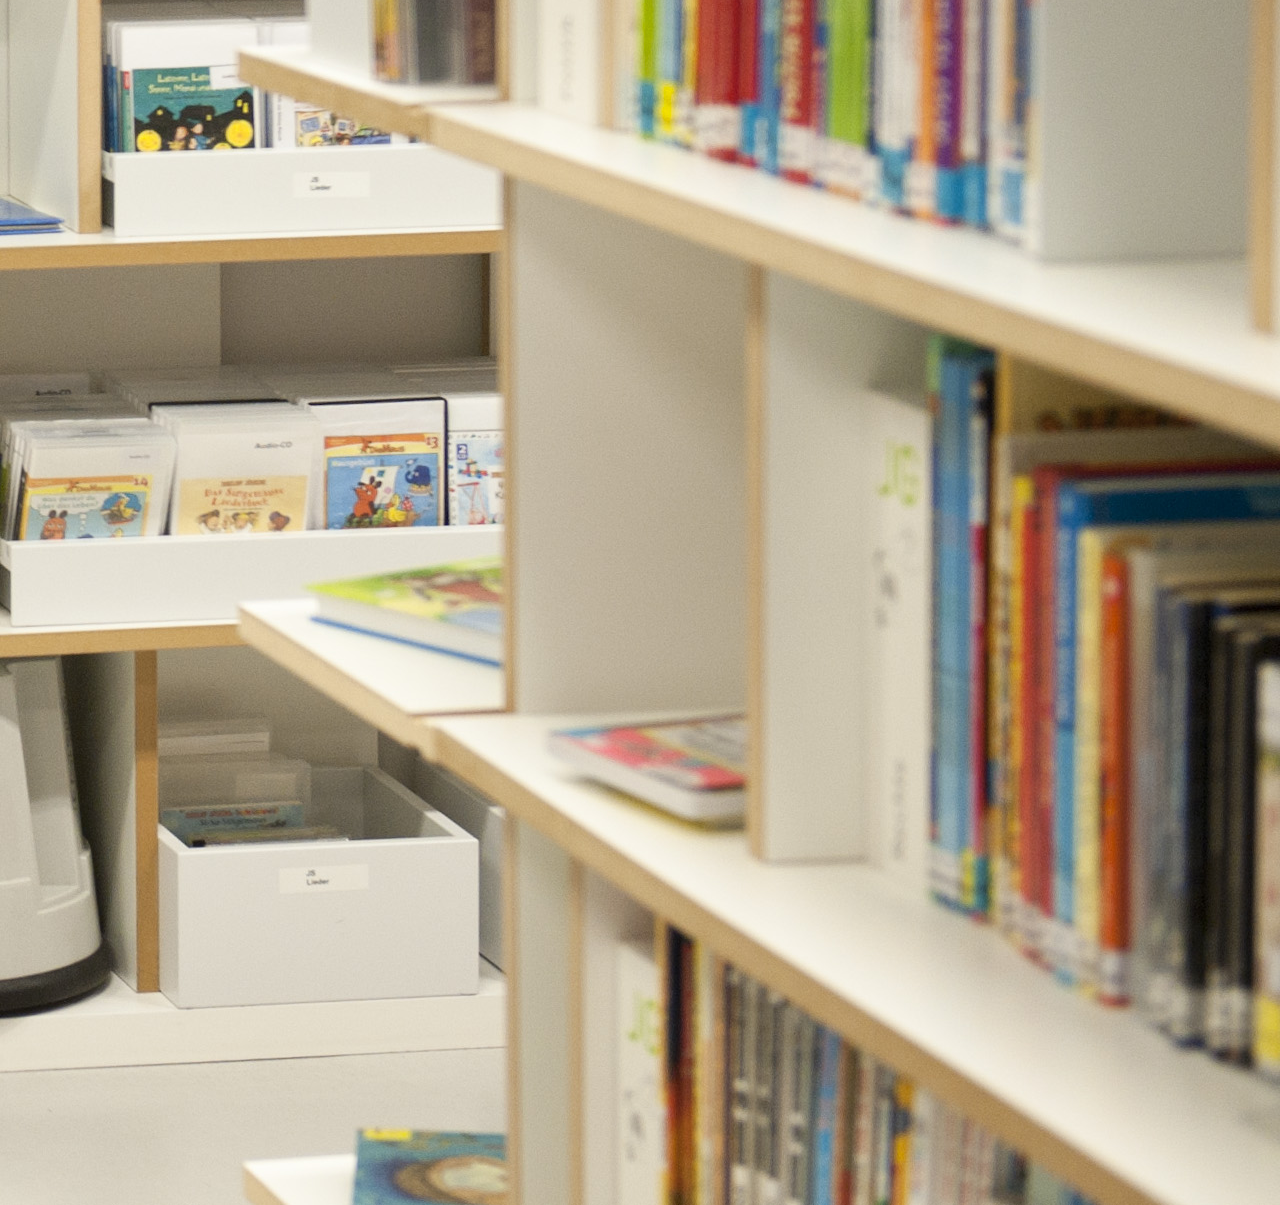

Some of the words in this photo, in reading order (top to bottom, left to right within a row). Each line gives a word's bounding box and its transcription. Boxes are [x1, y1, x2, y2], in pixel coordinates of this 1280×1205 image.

[310, 184, 332, 192] Lieder
[255, 441, 292, 449] Audio-CD
[458, 445, 467, 454] 2
[306, 878, 330, 886] Lieder
